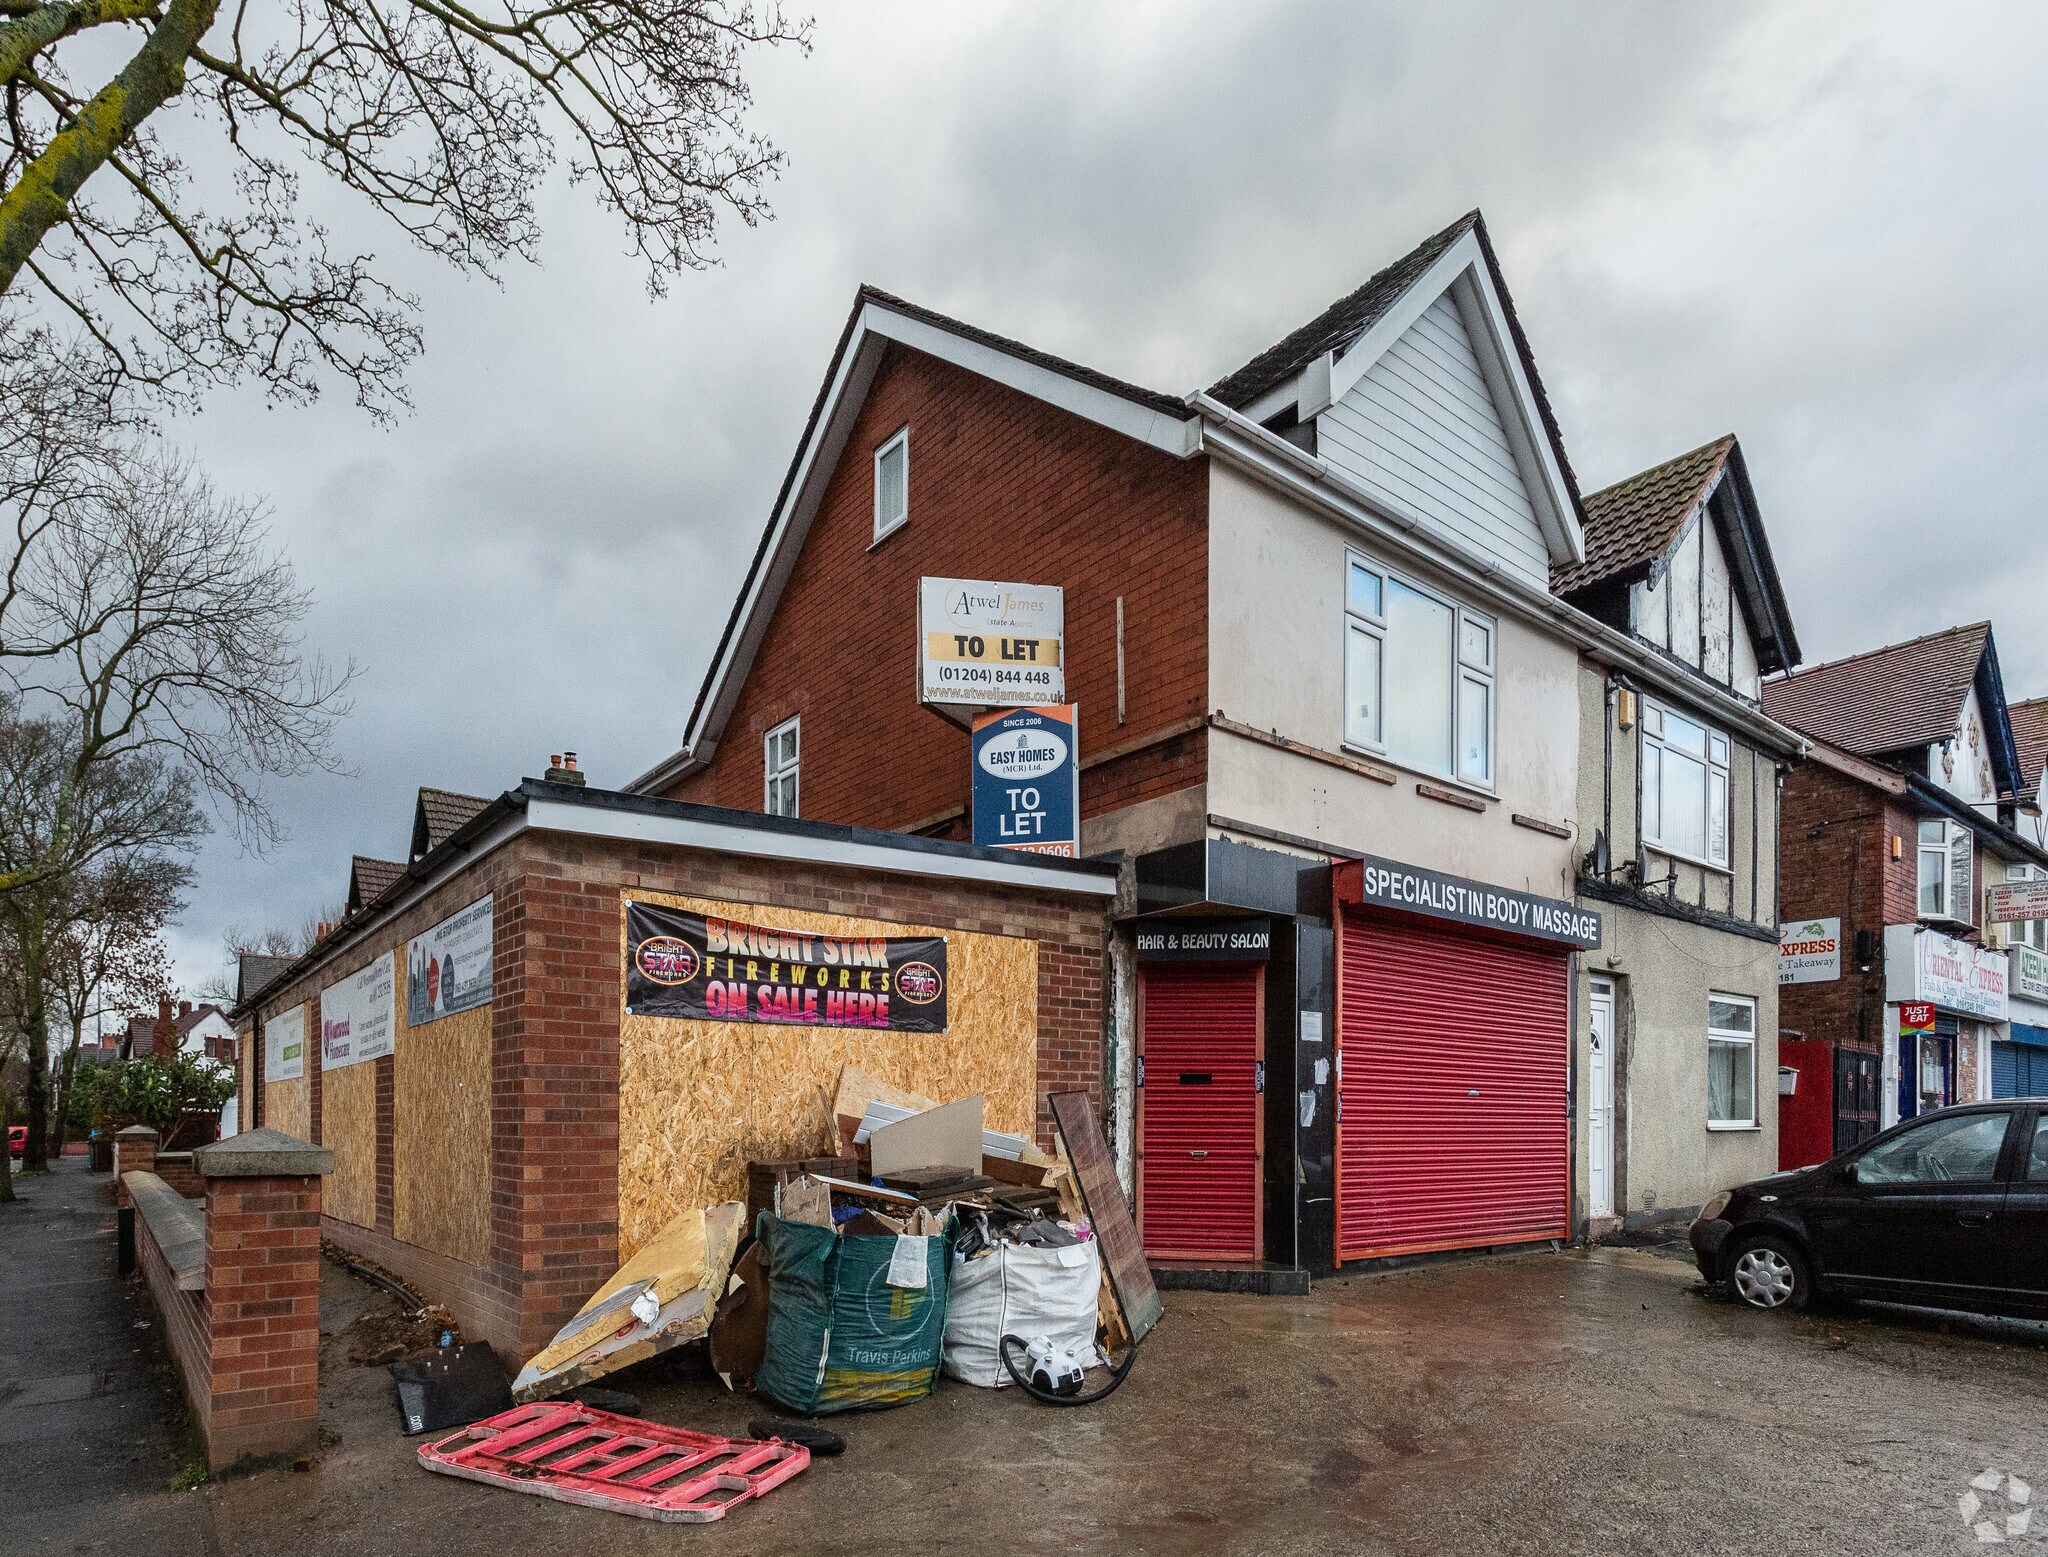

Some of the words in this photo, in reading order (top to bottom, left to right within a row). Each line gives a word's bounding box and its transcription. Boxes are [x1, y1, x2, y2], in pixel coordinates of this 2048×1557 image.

[951, 592, 1000, 615] Atwel
[1001, 592, 1044, 619] James
[954, 635, 985, 658] TO
[1001, 638, 1039, 661] LET
[939, 666, 992, 684] (01204)
[995, 670, 1021, 684] 844
[1024, 671, 1050, 684] 448
[927, 687, 1064, 704] www.atweljames.co.uk
[1003, 718, 1024, 728] SINCE
[990, 751, 1016, 765] EASY
[1019, 748, 1055, 762] HOMES
[1002, 765, 1027, 774] (MCR)
[1005, 787, 1041, 811] TO
[1000, 811, 1047, 836] LET
[1364, 866, 1467, 914] SPECIALIST
[1468, 890, 1484, 918] IN
[1486, 894, 1530, 926] BODY
[1532, 904, 1597, 941] MASSAGE
[1998, 911, 2030, 920] 0161-257
[650, 942, 684, 954] BRIGHT
[706, 918, 817, 962] BRIGHT
[822, 935, 889, 968] STAR
[1138, 934, 1165, 950] HAIR
[1168, 934, 1178, 950] &
[1182, 934, 1228, 949] BEAUTY
[1230, 933, 1269, 949] SALON
[1778, 938, 1836, 956] XPRESS
[644, 952, 691, 972] STAR
[1786, 958, 1835, 969] Takeaway
[1924, 931, 1964, 983] ORIENTAL
[1969, 946, 2003, 995] EXPRESS
[706, 956, 890, 990] FIREWORKS
[906, 968, 931, 977] BRIGHT
[901, 976, 936, 992] STAR
[706, 980, 748, 1019] ON
[756, 984, 818, 1024] SALE
[826, 990, 890, 1027] HERE
[1905, 1006, 1929, 1016] JUST
[1910, 1014, 1929, 1022] EAT
[848, 1346, 888, 1364] Travis
[892, 1348, 931, 1365] Perkins
